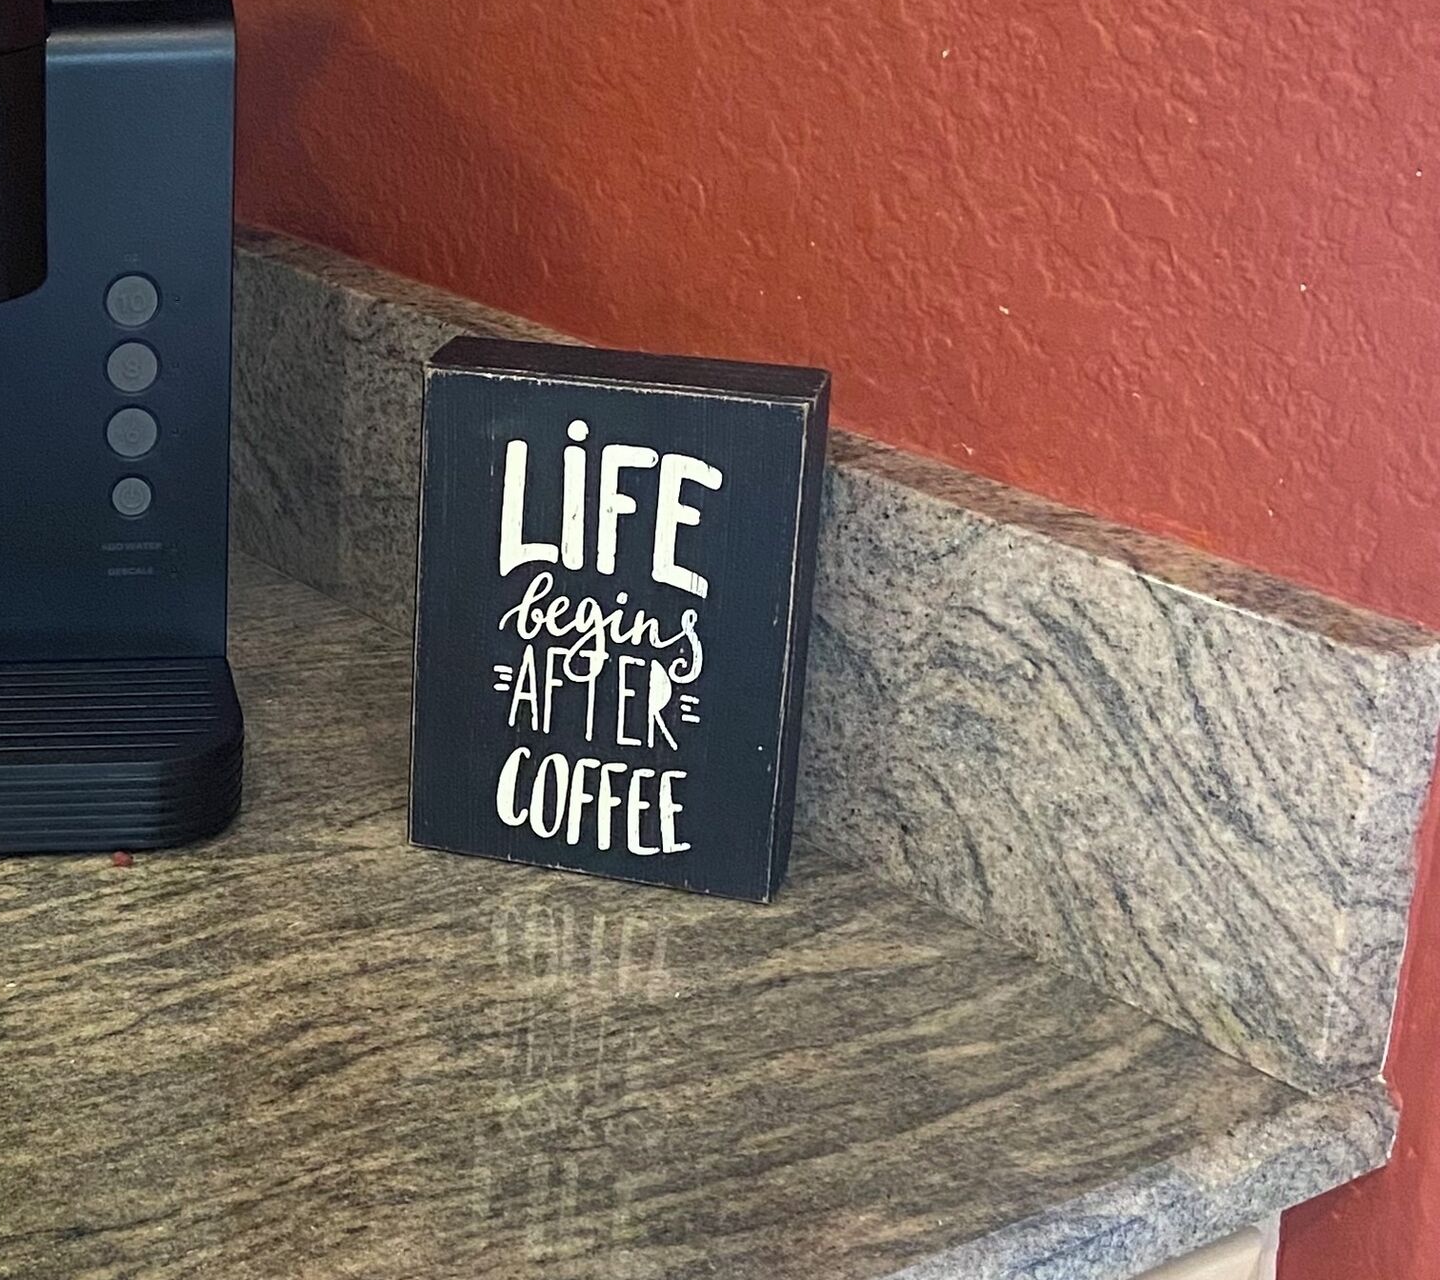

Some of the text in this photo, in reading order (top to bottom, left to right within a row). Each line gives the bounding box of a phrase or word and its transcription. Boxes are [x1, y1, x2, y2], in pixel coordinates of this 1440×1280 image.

[499, 572, 703, 683] begins
[509, 645, 678, 751] AFTER
[496, 747, 691, 856] COFFEE
